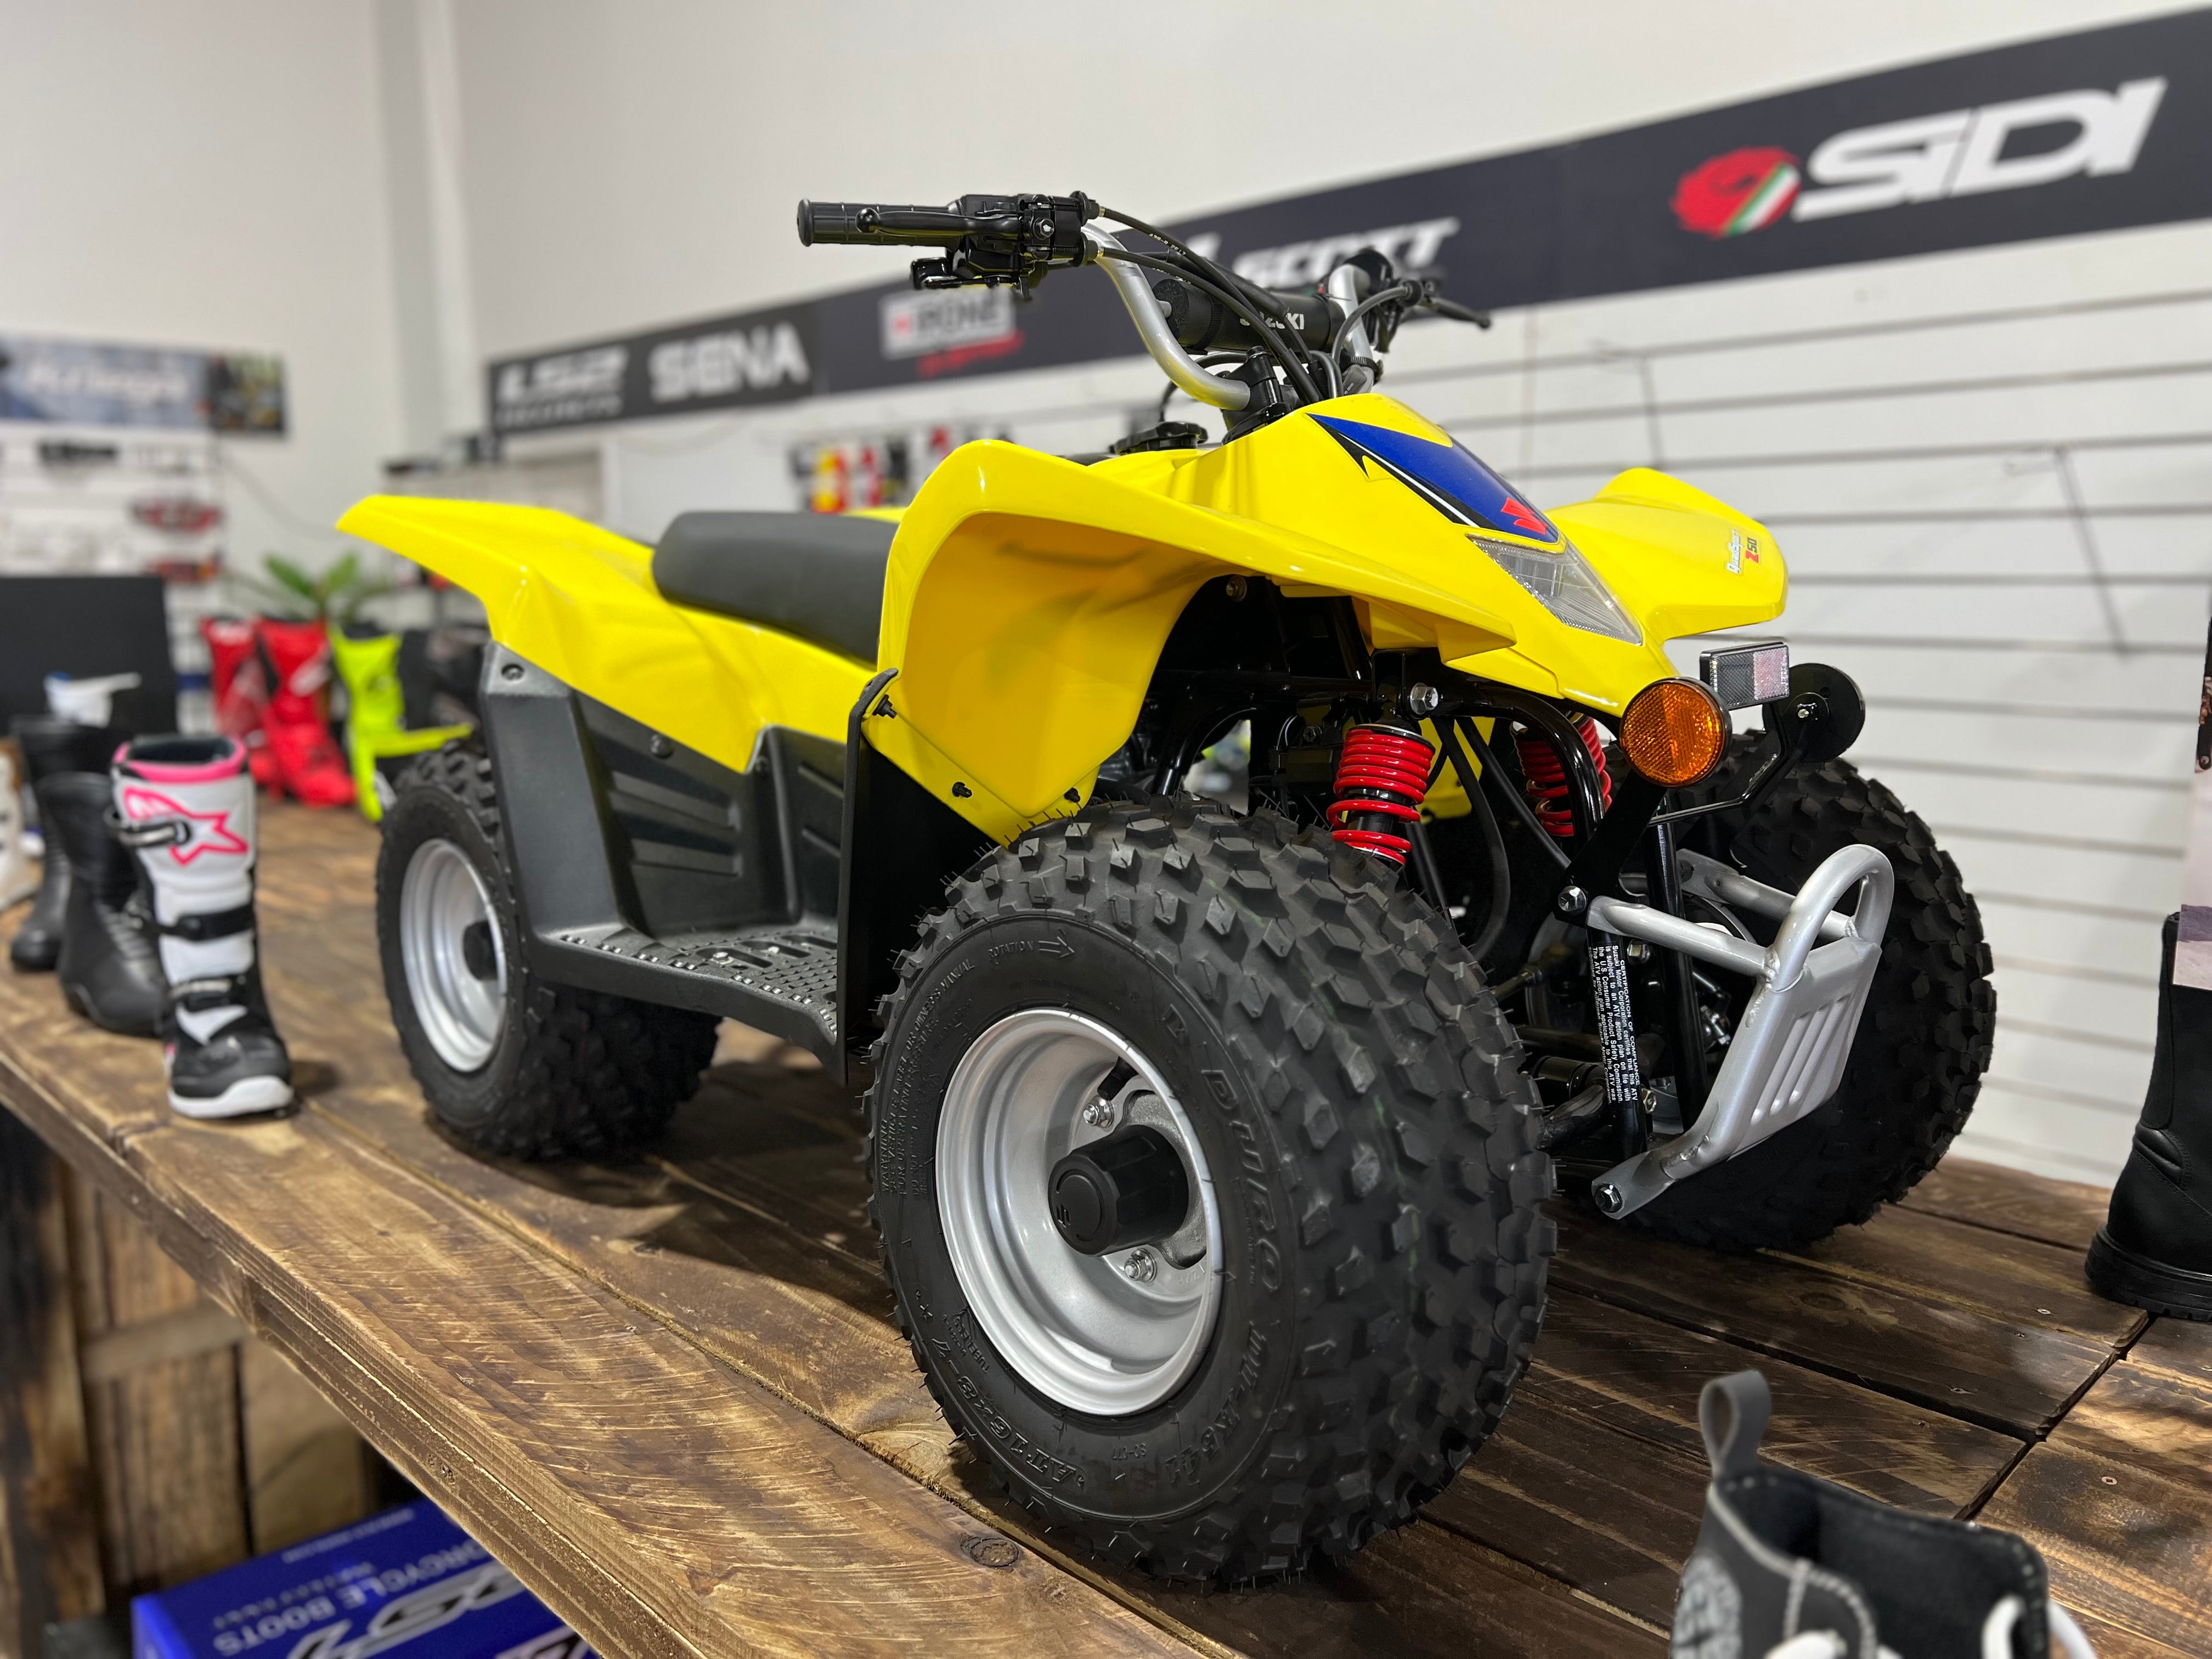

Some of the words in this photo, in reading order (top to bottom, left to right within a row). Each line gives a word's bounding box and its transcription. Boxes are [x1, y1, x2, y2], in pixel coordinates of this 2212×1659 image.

[1791, 75, 2168, 222] SIDI
[649, 323, 810, 403] SENA
[1745, 537, 1759, 563] Z50
[1588, 947, 1596, 977] submitted
[1606, 955, 1615, 978] subject
[1602, 976, 1611, 1009] Consumer
[1607, 1012, 1615, 1037] Product
[1611, 992, 1617, 1001] an
[1612, 945, 1621, 967] Suzuki
[1618, 990, 1627, 1028] Corporation
[1620, 960, 1632, 1018] CERTIFICATION
[1601, 1014, 1610, 1045] applicable
[1628, 1021, 1634, 1031] OF
[1617, 1044, 1625, 1058] plan
[1620, 1062, 1626, 1070] on
[1630, 1036, 1640, 1086] COMPLIANCE
[1200, 1069, 1283, 1293] DURO
[213, 1596, 336, 1656] BOOTS
